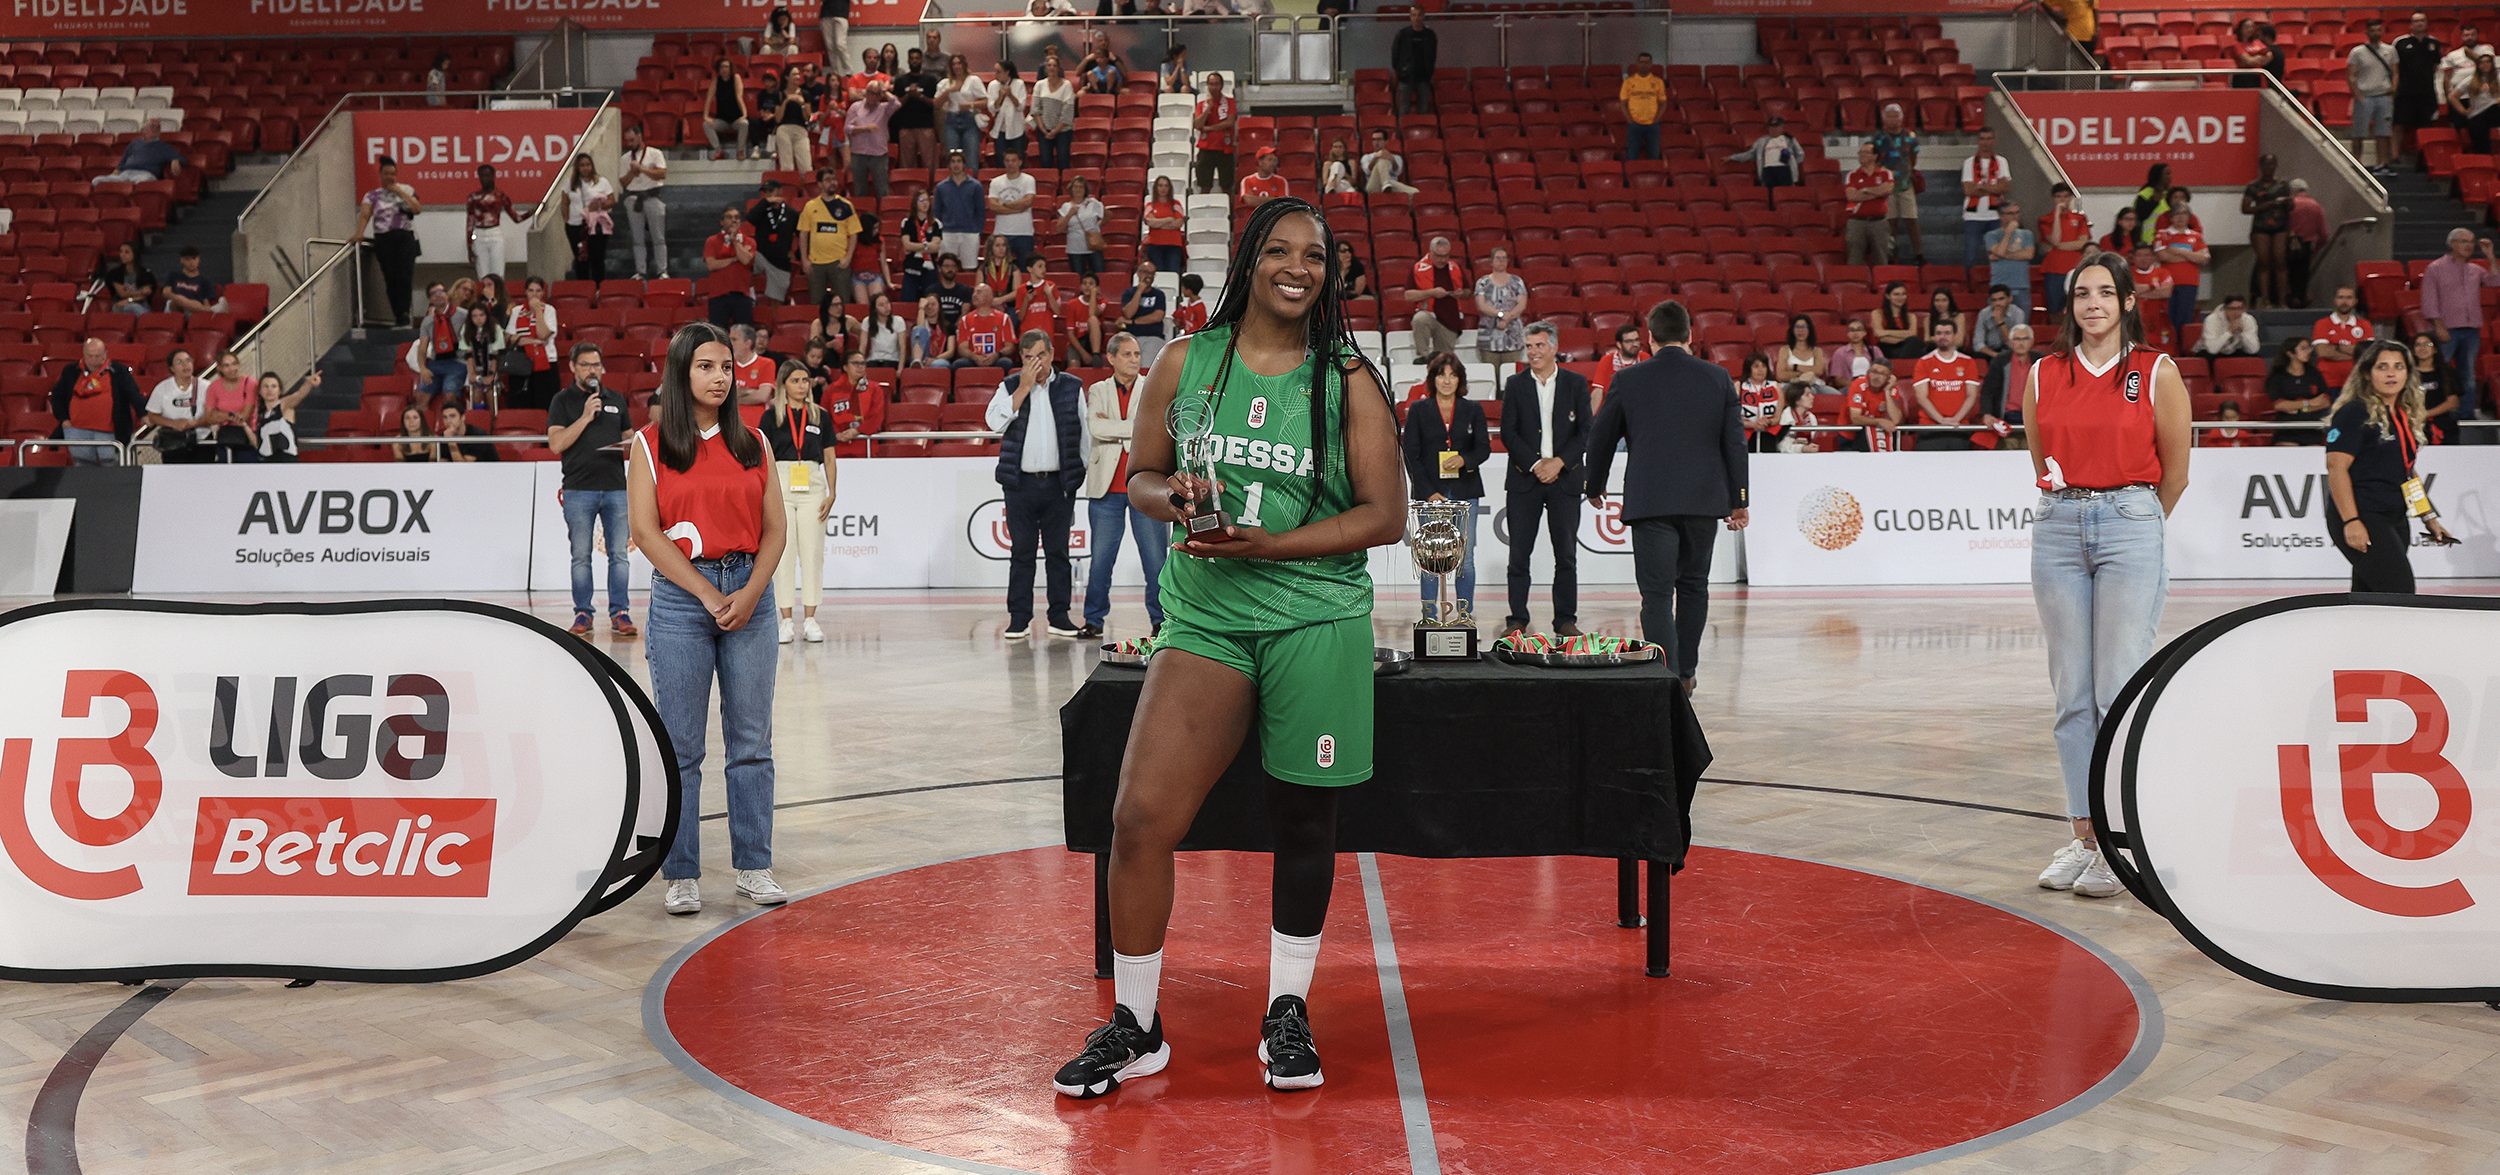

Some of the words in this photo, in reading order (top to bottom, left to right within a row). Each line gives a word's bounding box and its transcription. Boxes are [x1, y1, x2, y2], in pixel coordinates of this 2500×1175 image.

[2028, 115, 2247, 146] IDELIDADE
[366, 134, 582, 165] FIDELIDAD
[416, 170, 469, 180] SEGUROS
[833, 401, 850, 413] 251
[237, 488, 434, 535] AVBOX
[1236, 481, 1264, 528] 1
[825, 514, 879, 537] GEM
[1873, 508, 1980, 532] GLOBAL
[1988, 507, 2035, 531] IMA
[2241, 531, 2324, 552] Soluções
[235, 547, 316, 568] Soluções
[320, 546, 431, 563] Audiovisuais
[211, 814, 471, 878] Betclic
